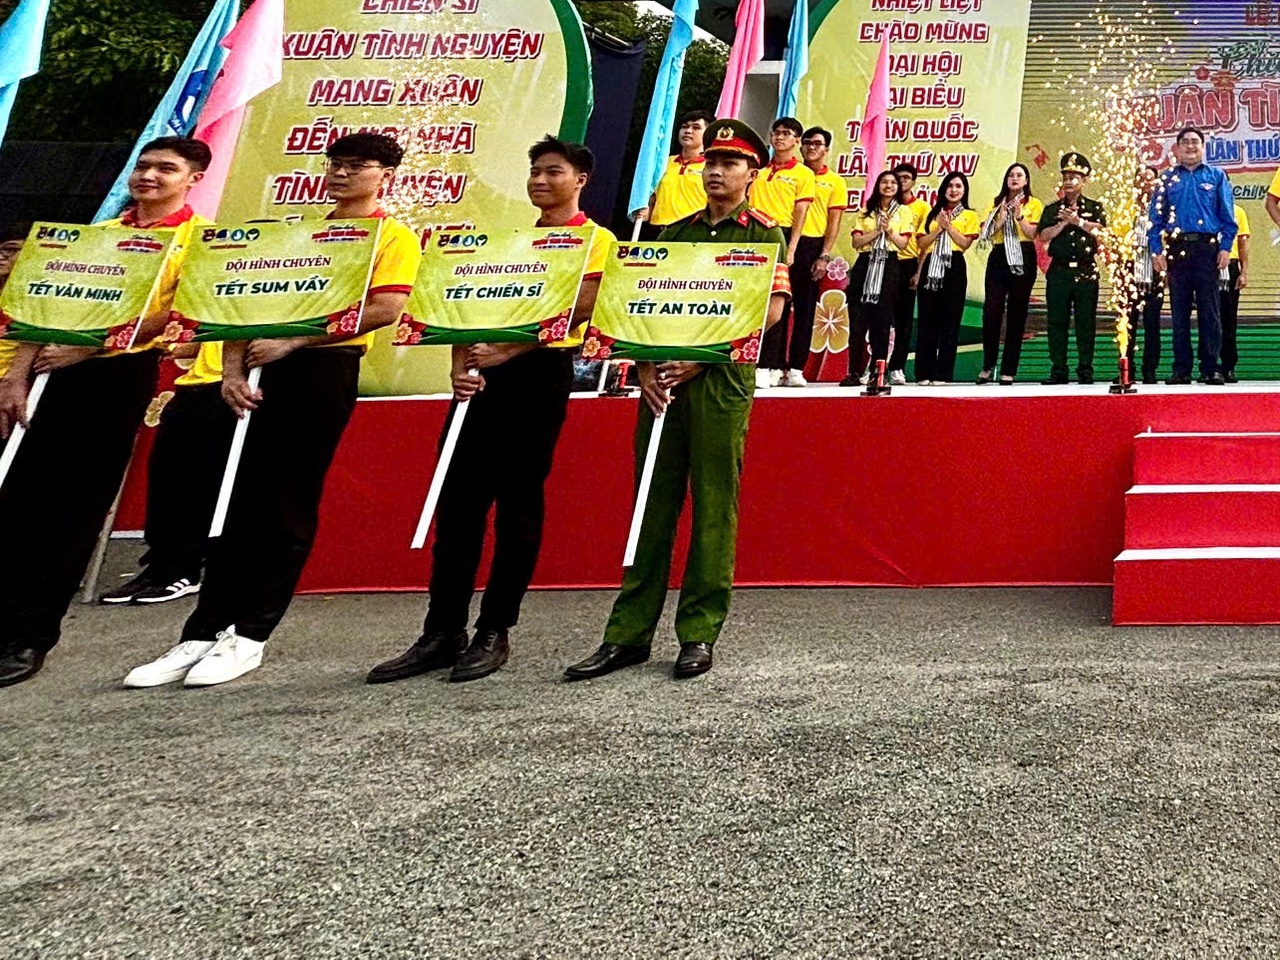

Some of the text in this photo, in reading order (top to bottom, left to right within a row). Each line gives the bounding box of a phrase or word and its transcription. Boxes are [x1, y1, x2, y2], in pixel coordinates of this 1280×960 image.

[859, 19, 988, 42] CHÀO MỪNG
[363, 29, 428, 59] TÌNH
[431, 28, 543, 61] NGUYỆN
[922, 51, 962, 77] HỘI
[308, 79, 392, 105] MANG
[889, 78, 965, 109] ẠI BIỂU
[912, 113, 978, 140] QUỐC
[938, 154, 979, 176] XIV
[225, 253, 332, 273] ĐỘI HÌNH CHUYÊN
[454, 260, 549, 279] ĐỘI HÌNH CHUYÊN
[27, 280, 54, 297] TẾT
[84, 287, 123, 303] MINH
[215, 278, 248, 297] TẾT
[250, 280, 293, 296] SUM
[444, 280, 545, 300] TẾT CHIẾN SĨ
[638, 278, 733, 294] ĐỘI HÌNH CHUYÊN
[627, 298, 732, 316] TẾT AN TOÀN
